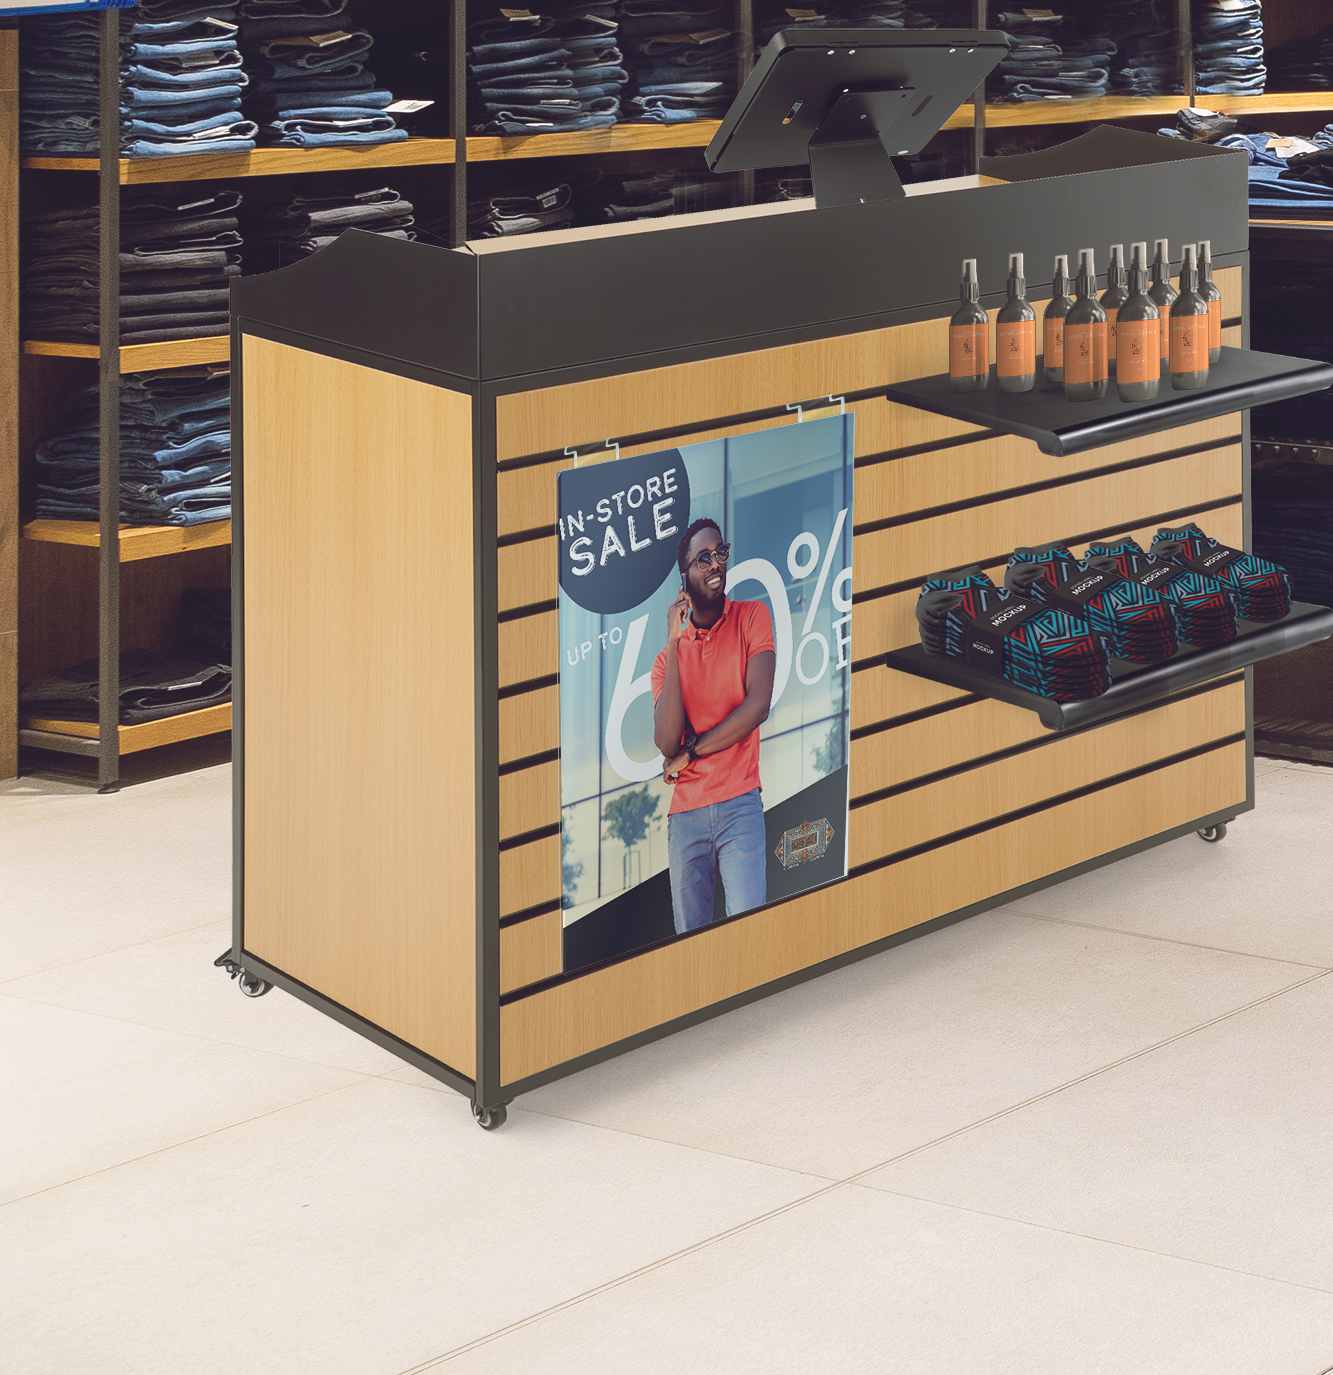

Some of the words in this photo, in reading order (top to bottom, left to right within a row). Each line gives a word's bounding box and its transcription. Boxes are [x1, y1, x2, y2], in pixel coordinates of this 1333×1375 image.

[559, 467, 679, 541] IN-STORE
[569, 496, 679, 576] SALE
[1204, 550, 1230, 567] MOCKUP
[1072, 575, 1103, 595] MOCKUP
[1141, 567, 1169, 585] MOCKUP
[991, 604, 1027, 627] MOCKUP
[567, 640, 593, 666] UP
[598, 626, 623, 650] TO
[972, 643, 995, 655] MOCKUP
